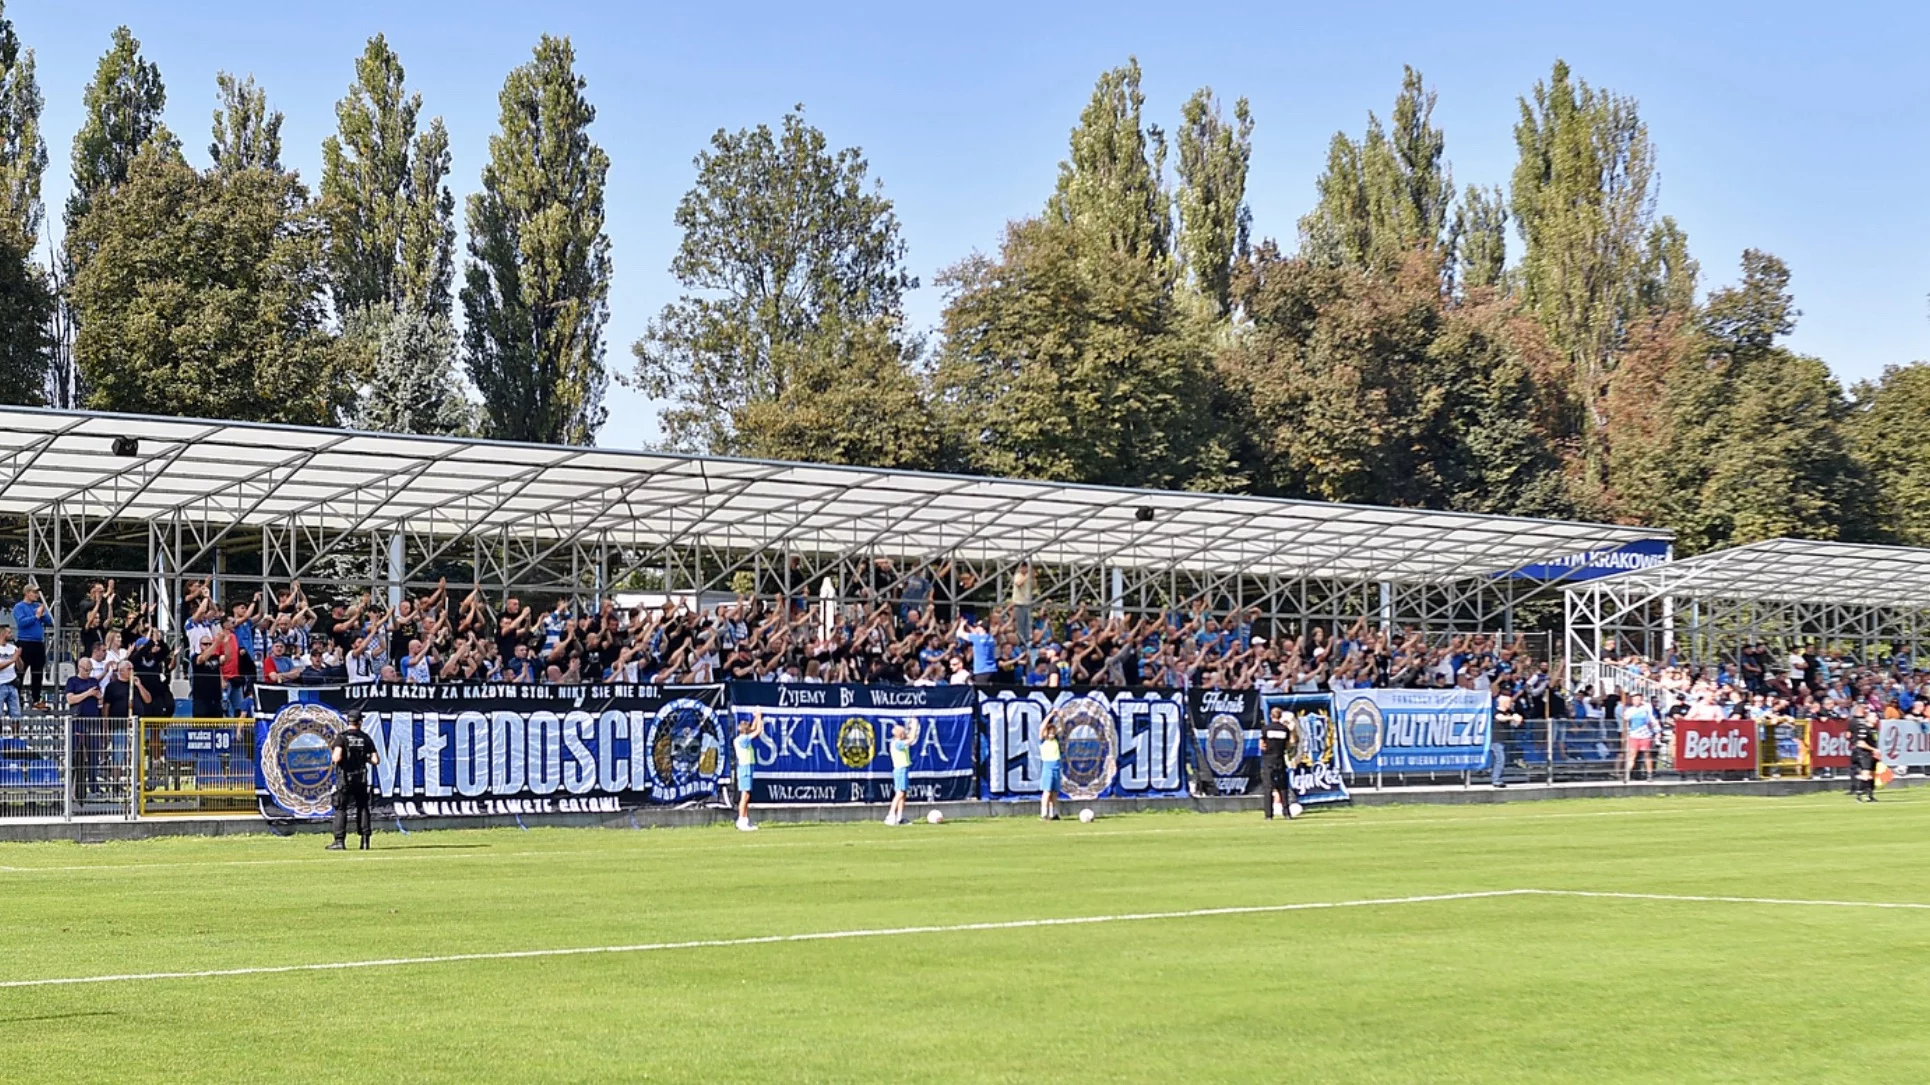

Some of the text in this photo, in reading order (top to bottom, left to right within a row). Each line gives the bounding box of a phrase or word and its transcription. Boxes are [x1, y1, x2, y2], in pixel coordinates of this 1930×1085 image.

[345, 685, 387, 698] TUTAJ
[442, 685, 458, 698] ZA
[463, 683, 517, 698] KAŻDYM
[614, 685, 634, 698] NIE
[215, 732, 230, 749] 30
[362, 698, 645, 797] MŁODOŚCI
[982, 701, 1042, 792] 19
[1119, 702, 1180, 790] 50
[1684, 729, 1748, 759] Betclic
[1817, 730, 1850, 757] Betc
[1906, 733, 1930, 752] 2 LI
